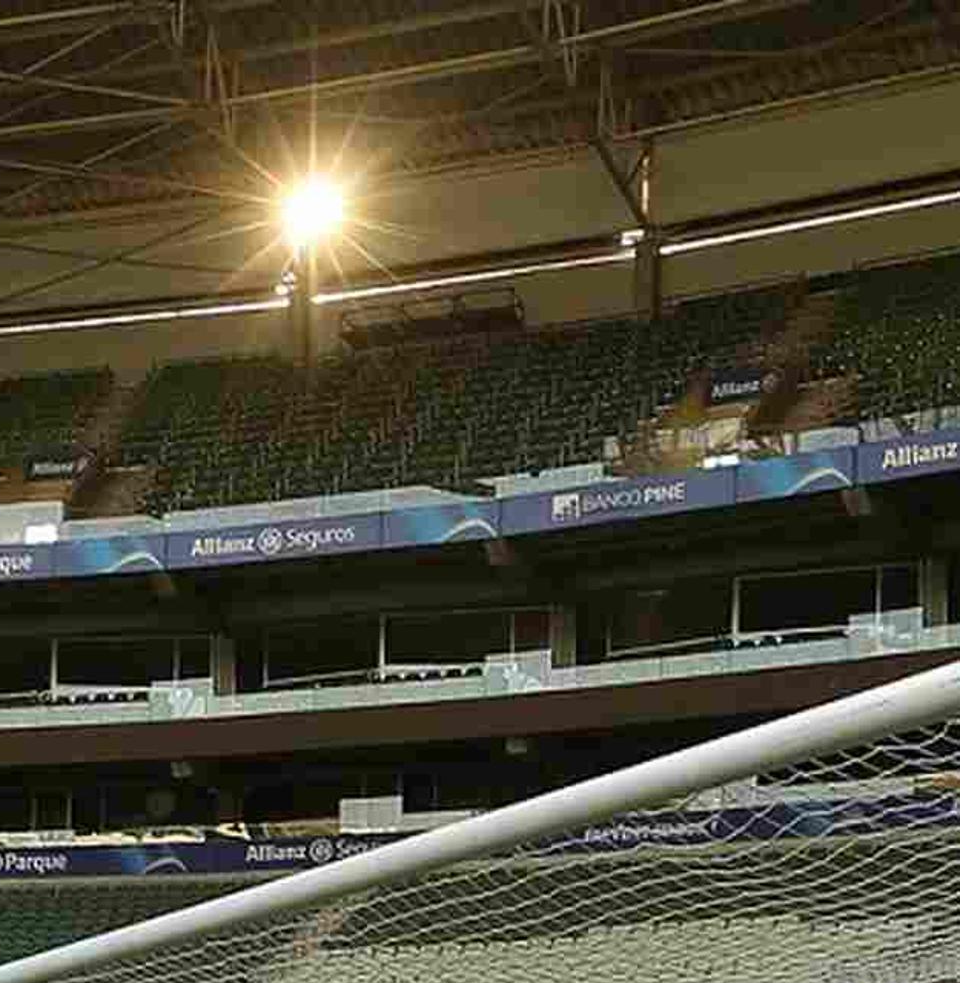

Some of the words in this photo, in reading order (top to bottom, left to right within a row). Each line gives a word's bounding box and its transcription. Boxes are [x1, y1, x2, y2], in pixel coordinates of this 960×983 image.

[882, 442, 958, 471] Allianz
[643, 481, 686, 504] PINE
[191, 537, 255, 557] Allianz
[285, 526, 355, 550] Seguros
[5, 852, 68, 874] Parque
[245, 844, 307, 862] Allianz
